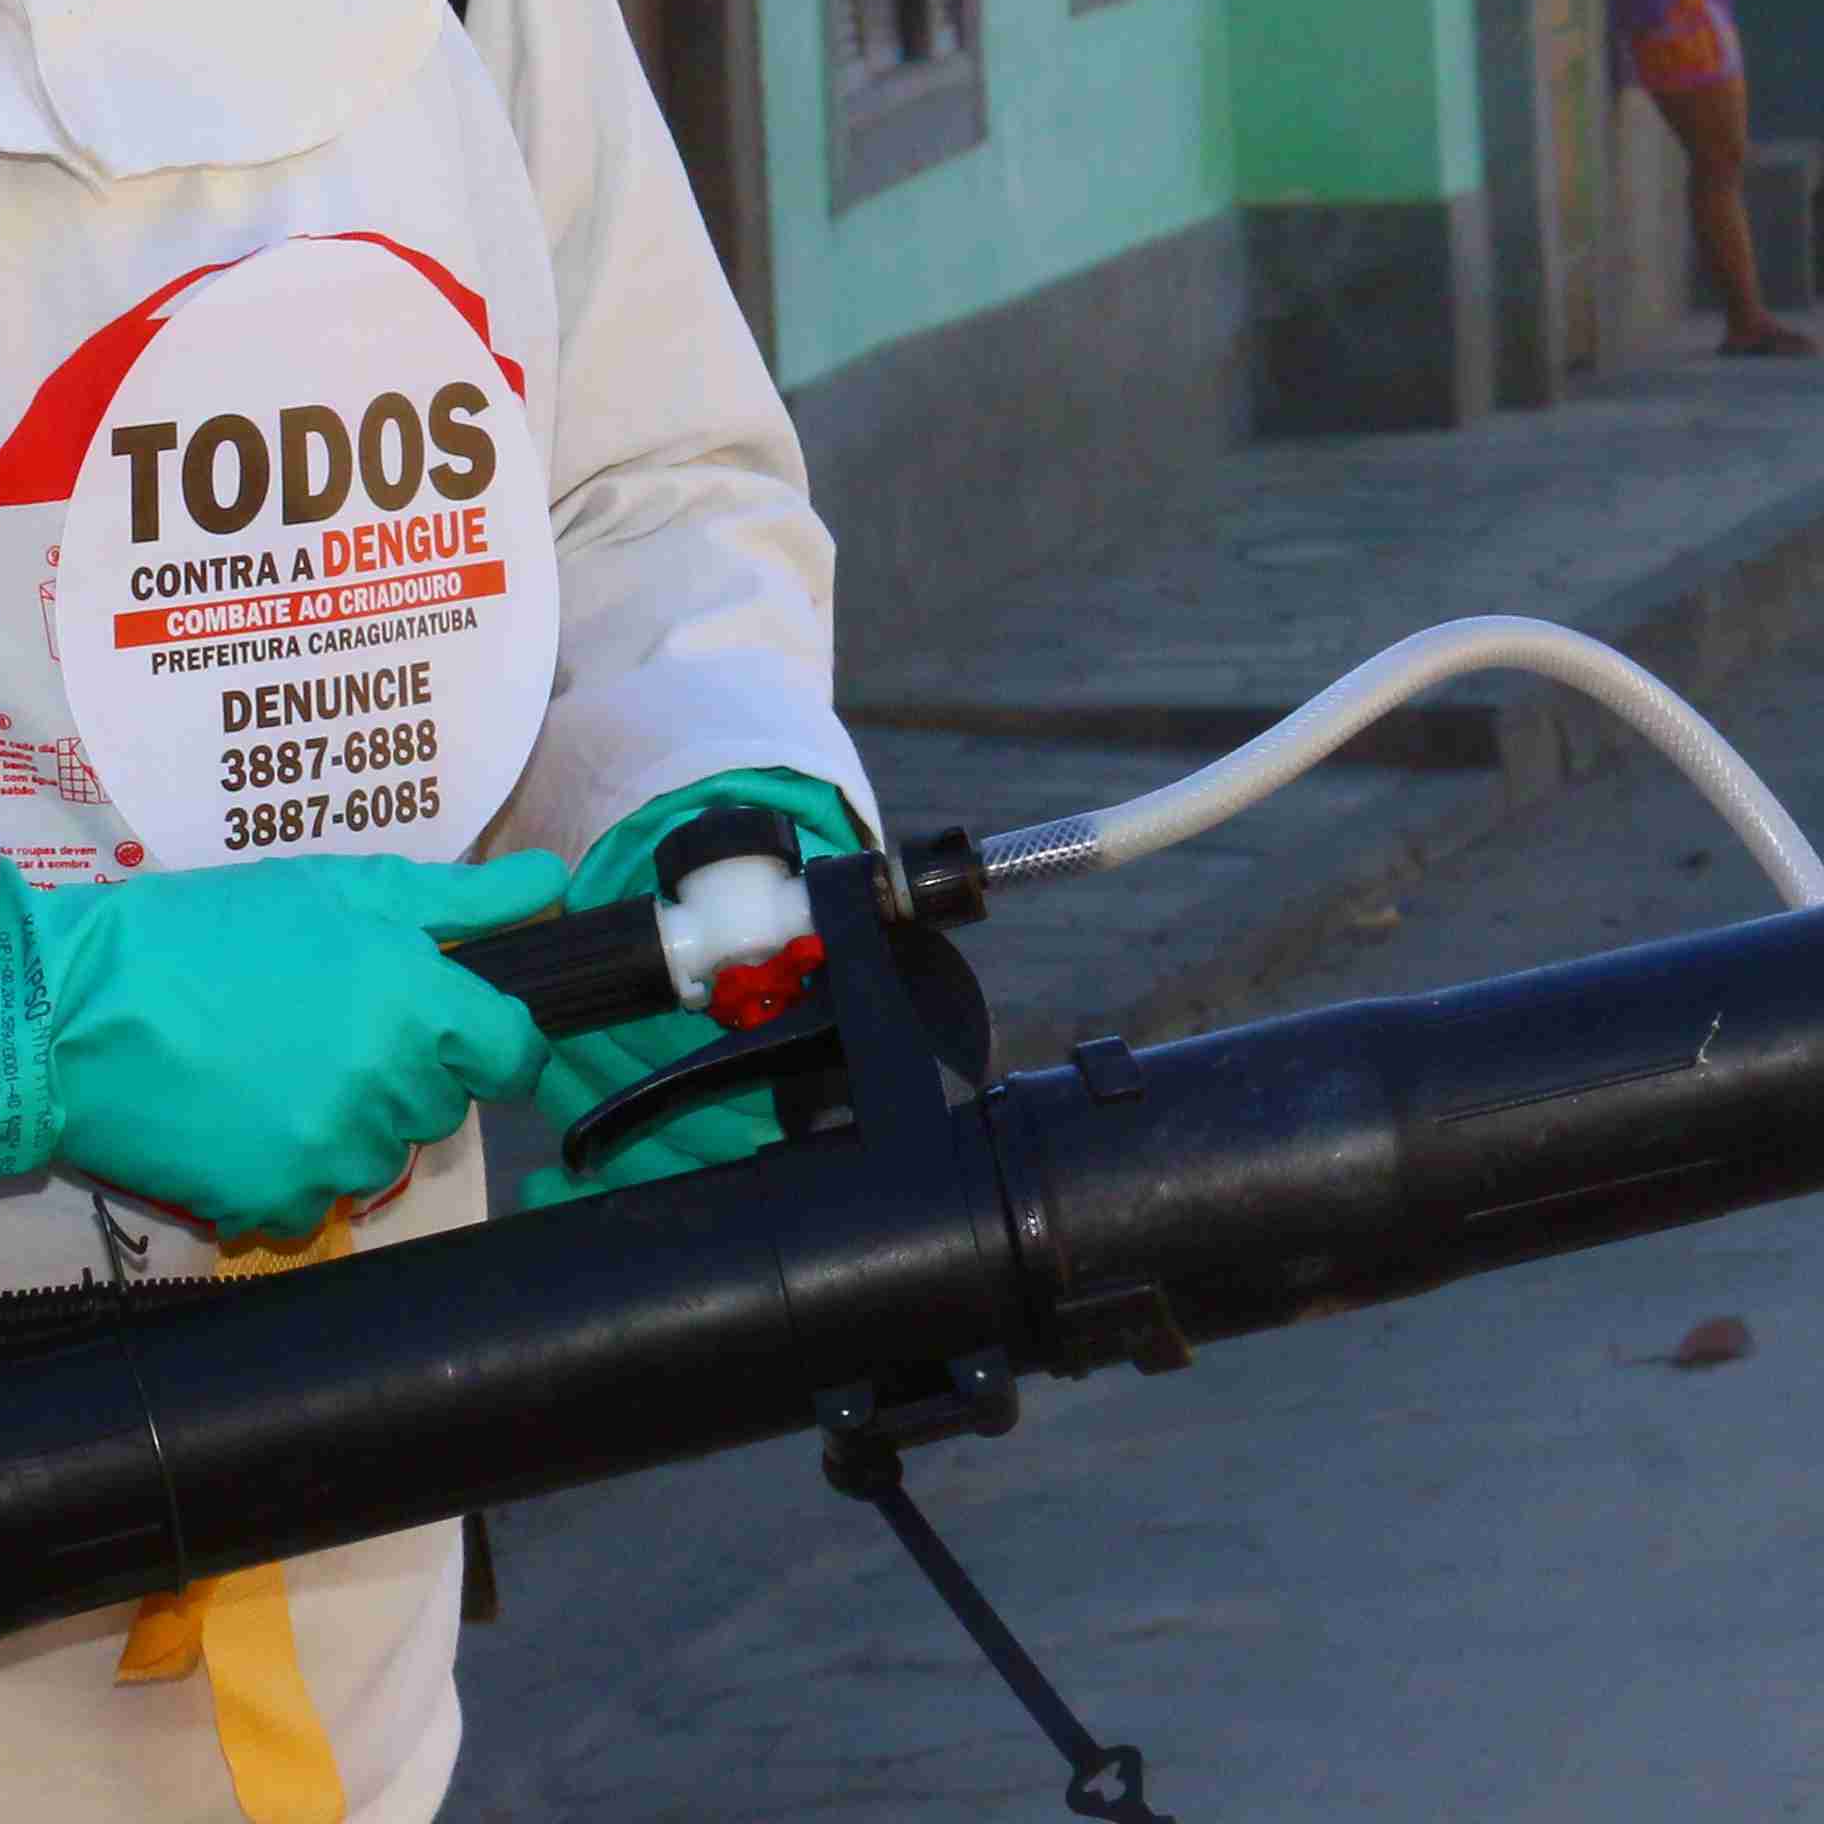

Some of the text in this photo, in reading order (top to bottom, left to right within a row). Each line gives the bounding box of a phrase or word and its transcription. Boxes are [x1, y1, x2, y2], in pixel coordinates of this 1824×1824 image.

[111, 381, 497, 544] TODOS
[130, 506, 488, 602] CONTRA A DENGUE
[151, 606, 479, 676] PREFEITURA CARAGUATATUBA
[166, 571, 463, 639] COMBATE AO CRIADOURO
[222, 661, 432, 733] DENUNCIE
[3, 775, 28, 783] com
[220, 718, 438, 793] 3887-6888
[224, 776, 440, 851] 3887-6085
[59, 845, 97, 856] devem
